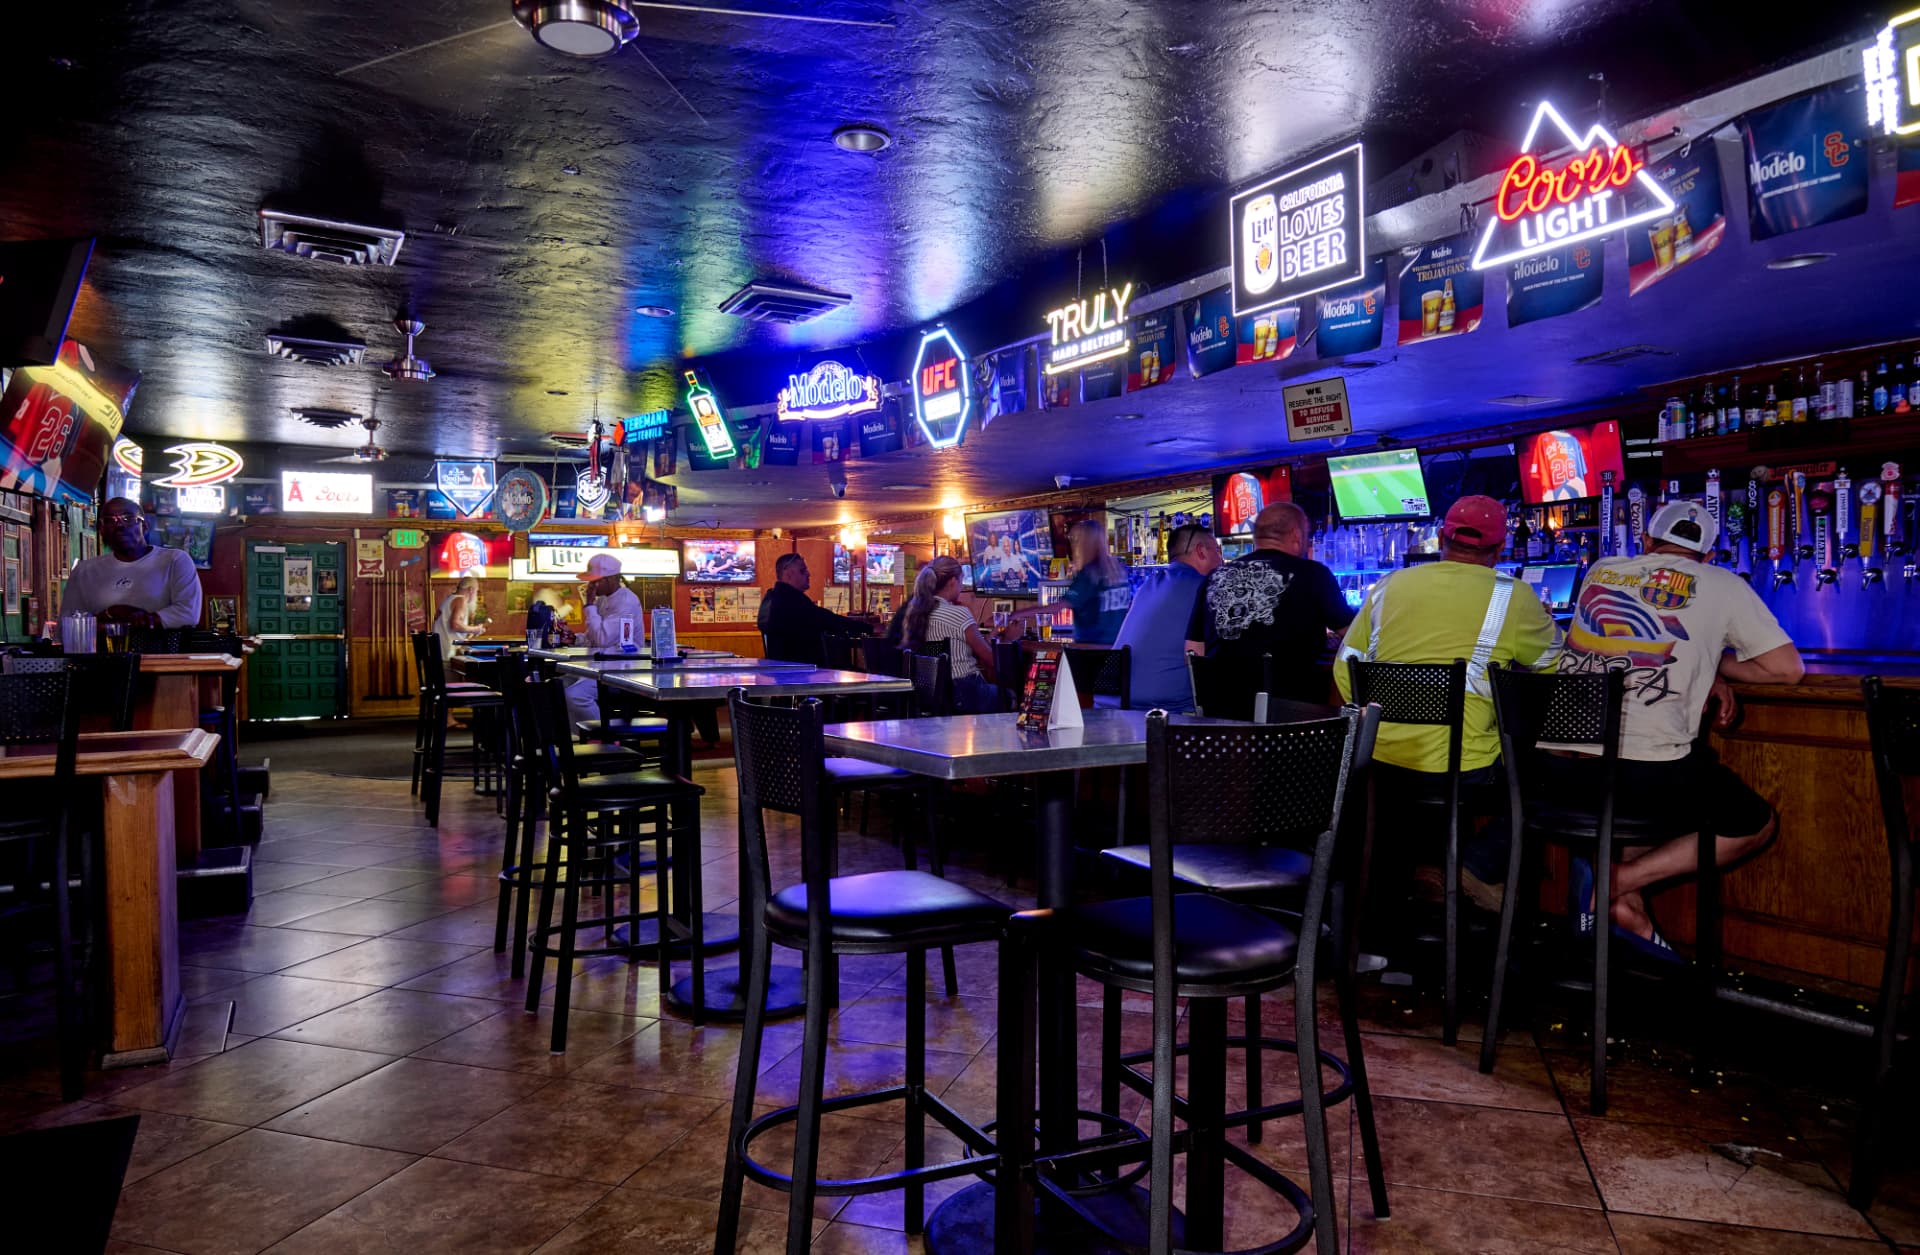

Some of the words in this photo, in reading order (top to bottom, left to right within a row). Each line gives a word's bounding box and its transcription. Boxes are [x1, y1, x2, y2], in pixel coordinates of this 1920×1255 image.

[1750, 152, 1806, 184] Modelo
[1280, 172, 1345, 212] CALIFORNIA
[1498, 145, 1643, 220] Coors
[1280, 194, 1345, 245] LOVES
[1519, 190, 1613, 247] LIGHT
[1281, 228, 1347, 282] BEER
[1514, 257, 1559, 281] Modelo
[1323, 302, 1355, 320] Modelo
[1052, 342, 1079, 363] HARD
[1080, 329, 1123, 354] SELTZER
[1190, 327, 1213, 345] Modelo
[789, 367, 863, 408] Modelo
[922, 358, 957, 396] UFC
[1288, 397, 1313, 409] RESERVE
[1313, 396, 1326, 406] THE
[1326, 393, 1342, 404] RIGHT
[1305, 387, 1322, 395] WE
[623, 409, 668, 432] TEREMANA
[1300, 409, 1309, 417] TO
[1309, 404, 1335, 416] REFUSE
[1305, 413, 1330, 425] SERVICE
[28, 406, 74, 462] 26
[637, 426, 662, 440] TEQUILA
[769, 434, 787, 445] Modelo
[863, 423, 884, 434] Modelo
[1304, 427, 1311, 435] TO
[1312, 423, 1336, 434] ANYONE
[1552, 459, 1576, 485] 26
[504, 493, 532, 506] Modelo
[1748, 480, 1757, 508] 805
[1239, 495, 1257, 520] 26
[1630, 502, 1643, 538] Coors
[396, 531, 417, 547] EXIT
[551, 549, 583, 567] Lite
